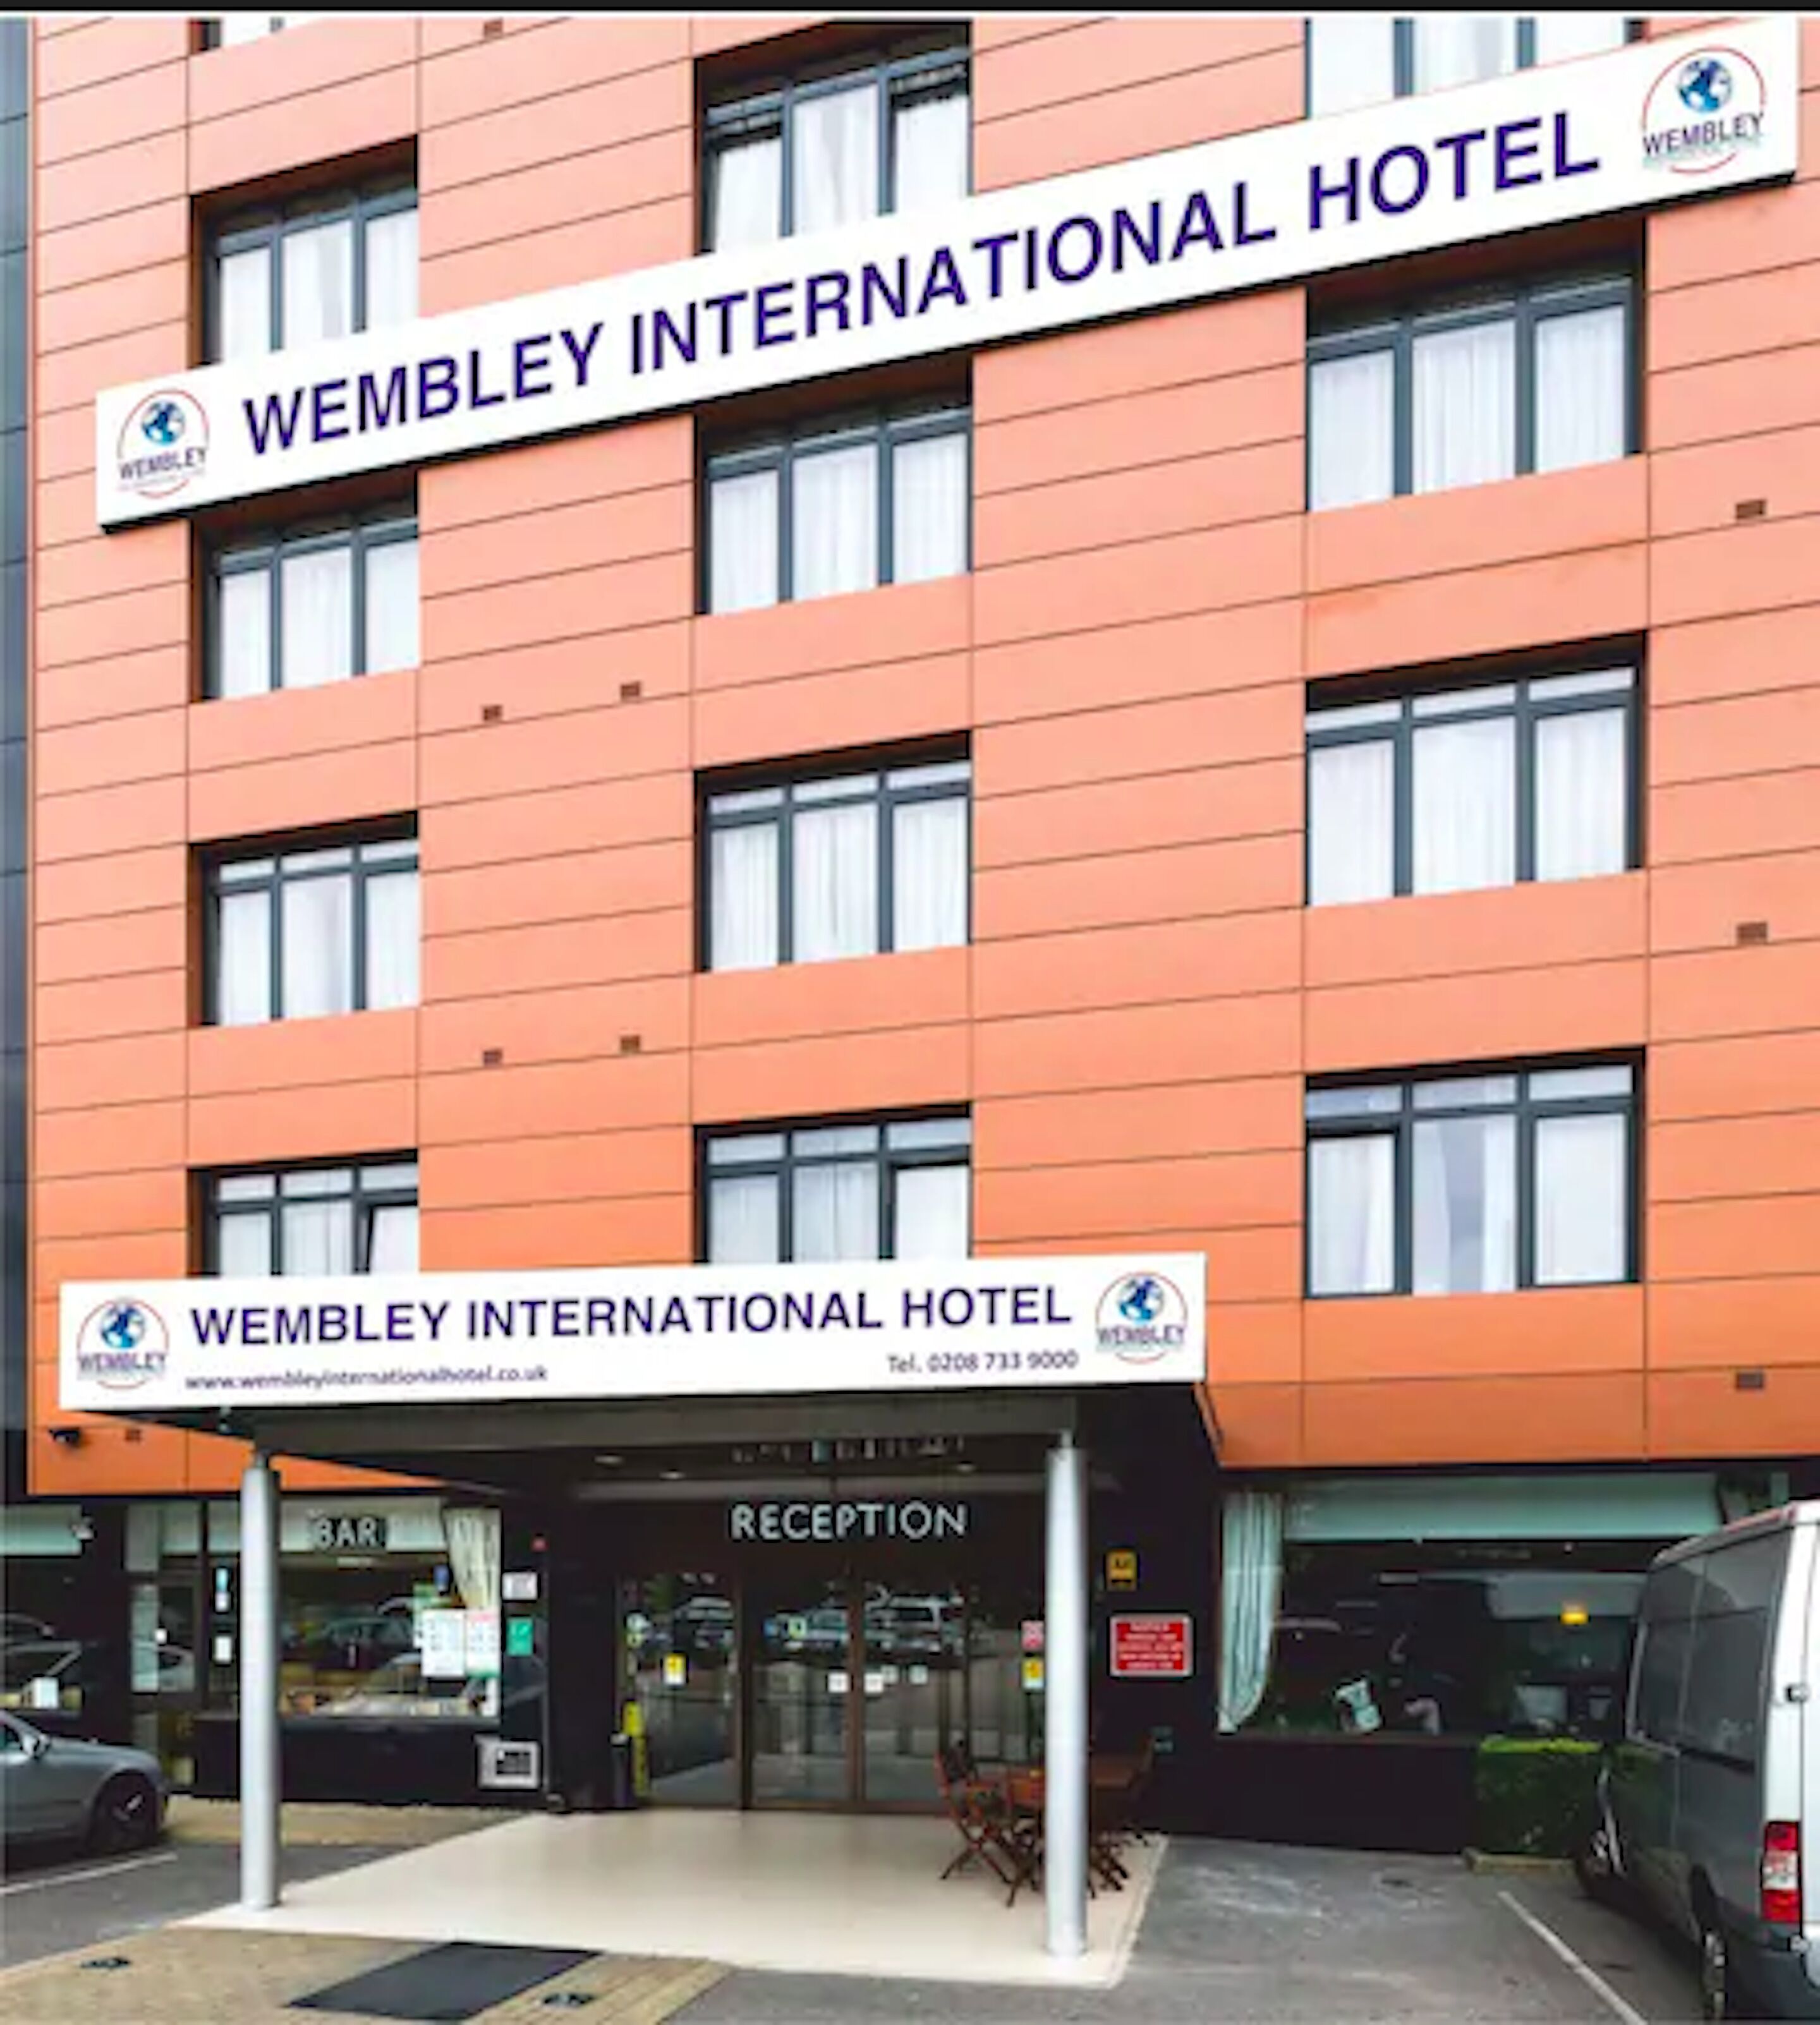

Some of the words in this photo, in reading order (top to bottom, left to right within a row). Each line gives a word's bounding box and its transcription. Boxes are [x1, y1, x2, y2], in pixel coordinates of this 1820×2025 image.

[1643, 111, 1764, 155] WEMBLEY
[243, 322, 604, 455] WEMBLEY
[631, 181, 1277, 375] INTERNATIONAL
[1309, 112, 1599, 230] HOTEL
[118, 445, 207, 480] WEMBLEY
[191, 1302, 449, 1346] WEMBLEY
[468, 1291, 883, 1339] INTERNATIONAL
[902, 1287, 1072, 1329] HOTEL
[1096, 1324, 1186, 1346] WEMBLEY
[77, 1351, 167, 1373] WEMBLEY
[186, 1365, 547, 1390] www.wembleyinternationalhotel.co.uk
[887, 1353, 921, 1374] Tel.
[927, 1352, 979, 1374] 0208
[985, 1351, 1022, 1370] 733
[1027, 1348, 1079, 1369] 9000
[315, 1516, 378, 1550] BAR
[731, 1501, 965, 1540] RECEPTION
